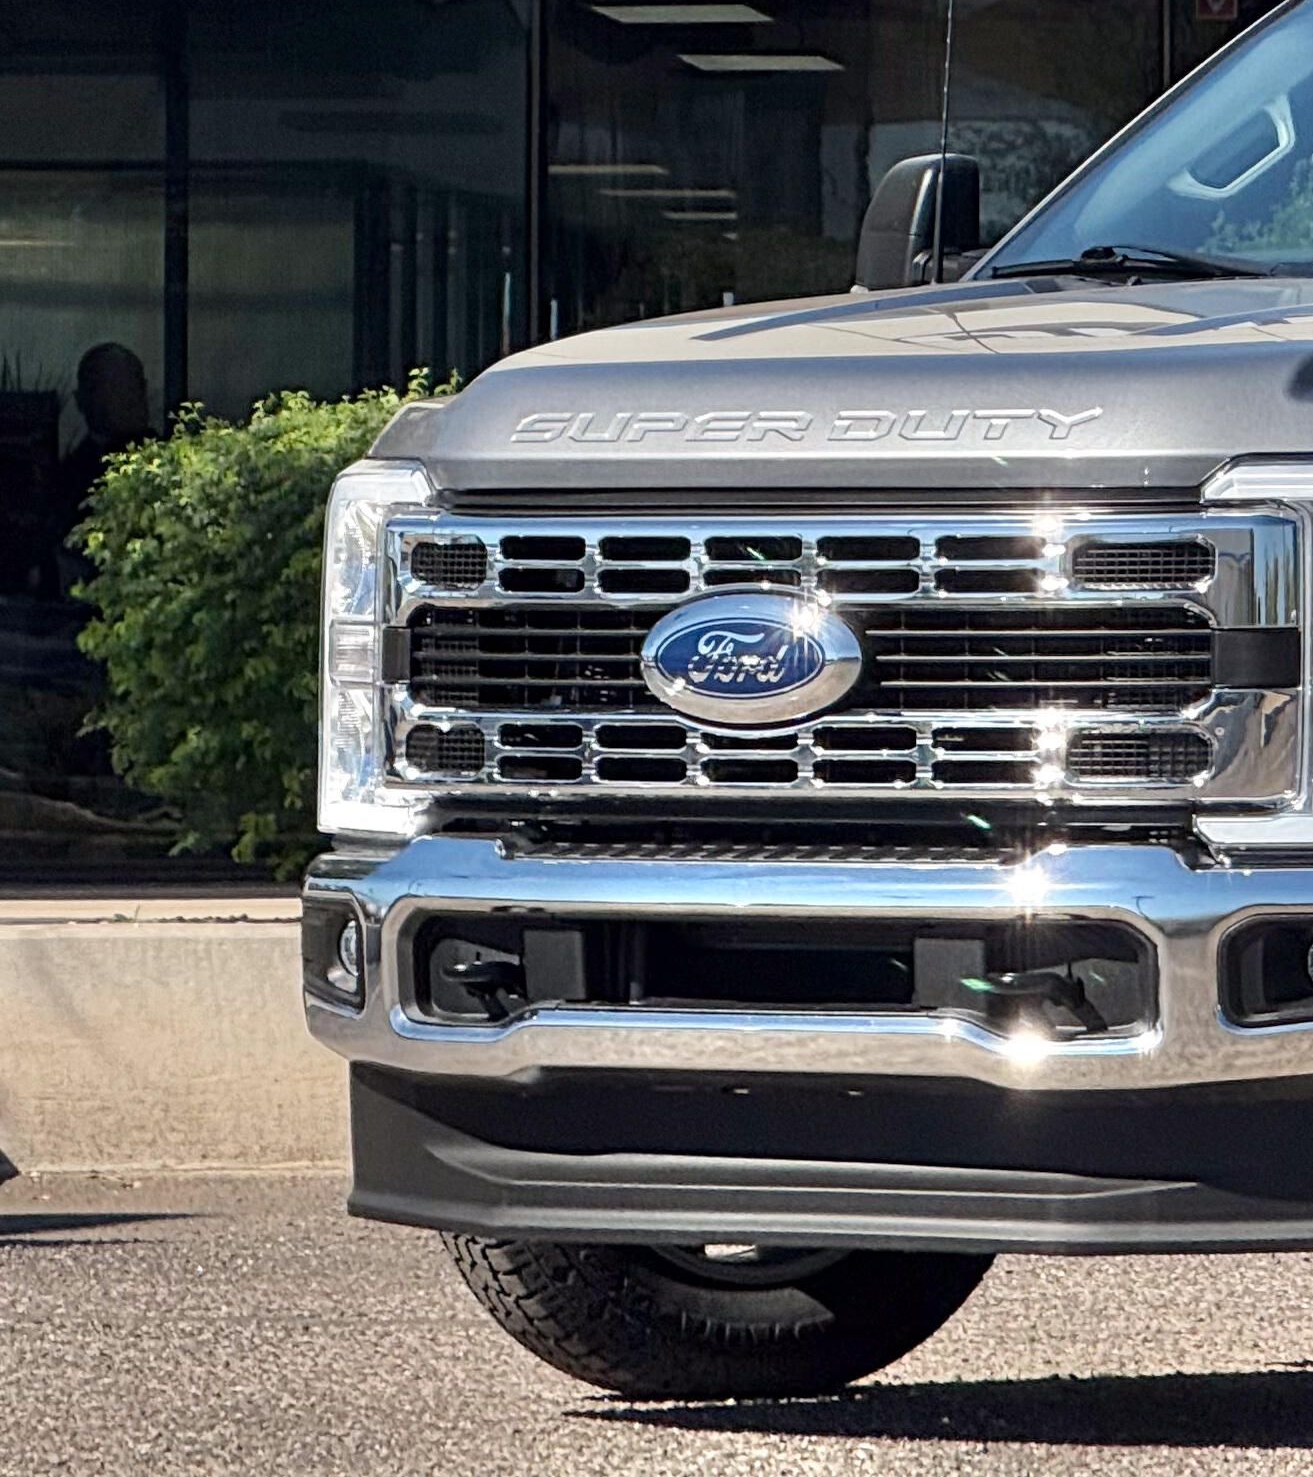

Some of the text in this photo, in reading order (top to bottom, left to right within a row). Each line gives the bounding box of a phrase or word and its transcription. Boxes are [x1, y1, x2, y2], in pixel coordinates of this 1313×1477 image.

[510, 406, 1103, 443] SUPER DUTY
[687, 630, 790, 684] Ford
